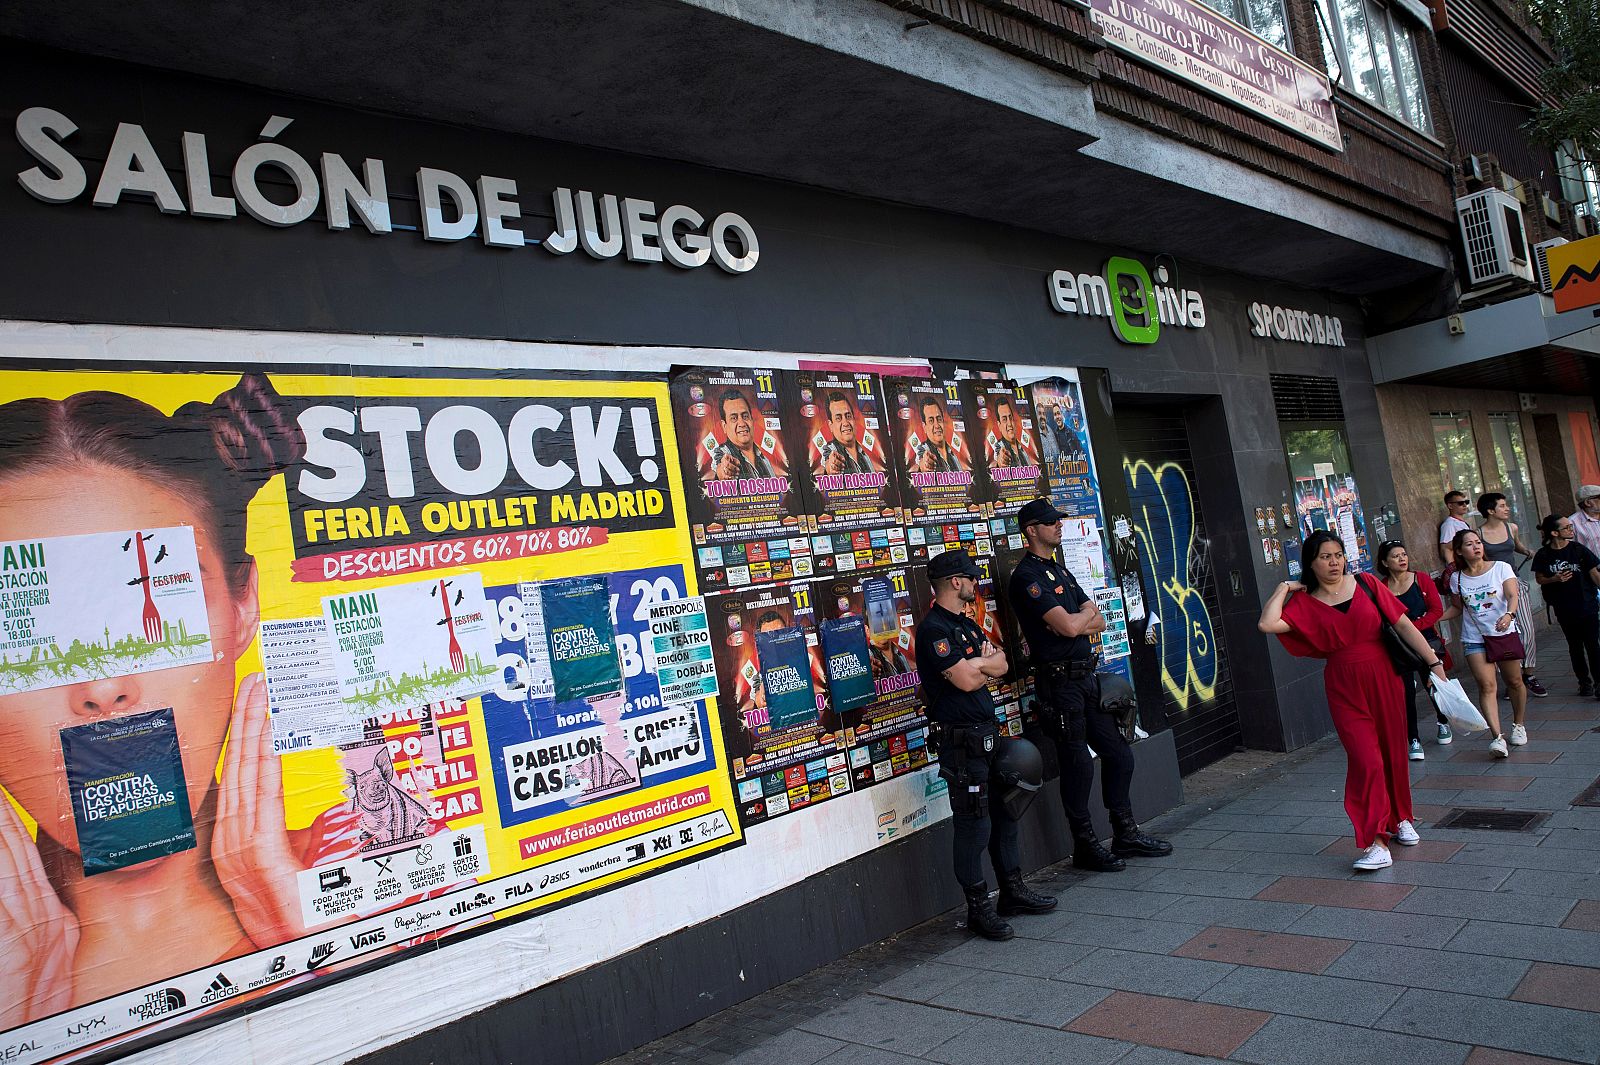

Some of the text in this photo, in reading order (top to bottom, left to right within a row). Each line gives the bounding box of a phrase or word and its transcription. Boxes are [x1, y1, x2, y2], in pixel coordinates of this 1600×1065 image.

[1136, 33, 1177, 67] Contable
[1185, 56, 1223, 89] Mercantil
[1231, 80, 1267, 110] Hipotecas
[15, 106, 760, 275] SALÓN DE JUEGO
[1247, 301, 1346, 348] SPORTS BAR
[757, 375, 773, 392] 11
[857, 380, 871, 394] 11
[757, 392, 777, 400] octubre
[946, 386, 958, 400] 11
[1015, 387, 1025, 399] 11
[297, 404, 659, 503] STOCK!
[815, 472, 886, 491] TONY ROSADO
[910, 470, 972, 488] TONY ROSADO
[991, 465, 1041, 482] TONY ROSADO
[704, 476, 789, 498] TONY ROSADO
[719, 494, 780, 505] CONCIERTO EXCLUSIVO
[303, 488, 665, 543] FERIA OUTLET MADRID
[3, 542, 46, 571] ANI
[323, 525, 593, 580] DESCUENTOS 60% 70% 80%
[789, 583, 810, 593] viernes
[892, 575, 906, 592] 11
[12, 596, 51, 609] VIVIENDA
[13, 588, 50, 601] DERECHO
[631, 574, 681, 622] 20
[793, 590, 810, 609] 11
[5, 607, 32, 619] DIGNA
[329, 592, 379, 621] MANI
[650, 601, 704, 618] METROPOLIS
[793, 607, 814, 616] octubre
[3, 617, 36, 632] 5/OCT
[1105, 610, 1123, 623] TEATRO
[262, 621, 304, 632] EXCURSIONES
[334, 614, 383, 637] FESTACIÓN
[652, 620, 679, 635] CINE
[8, 629, 33, 641] 18:00
[17, 635, 57, 649] BENAVENTE
[270, 638, 317, 648] BURGOS
[357, 637, 385, 649] VIVIENDA
[359, 631, 384, 642] DERECHO
[553, 627, 597, 644] CONTRA
[670, 631, 708, 647] TEATRO
[554, 636, 599, 652] LAS CASAS
[556, 651, 569, 661] DE
[568, 643, 610, 659] APUESTAS
[271, 649, 319, 659] VALLADOLID
[354, 648, 373, 658] DIGNA
[830, 654, 859, 668] CONTRA
[273, 660, 321, 670] SALAMANCA
[353, 655, 376, 668] 5/OCT
[832, 660, 861, 673] LAS CASAS
[273, 673, 309, 683] GUADALUPE
[364, 669, 391, 683] BENAVENTE
[676, 663, 714, 679] DOBLAJE
[767, 667, 799, 681] CONTRA
[834, 666, 868, 680] DE APUESTAS
[768, 674, 801, 686] LAS CASAS
[780, 680, 808, 692] APUESTAS
[879, 670, 922, 693] ROSADO
[634, 693, 660, 711] 10h
[512, 714, 688, 774] PABELLÓN CRISTA
[84, 770, 136, 788] MANIFESTACIÓN
[84, 773, 154, 801] CONTRA
[512, 763, 580, 802] CASA
[86, 784, 159, 812] LAS CASAS
[88, 790, 175, 822] DE APUESTAS
[523, 790, 707, 856] www.feriaoutletmadrid.com
[130, 837, 171, 853] Cuatro Caminos
[452, 854, 478, 867] SORTEO
[453, 861, 480, 874] 1000€
[578, 854, 622, 875] wonderbra
[407, 866, 437, 879] SERVICIO
[373, 882, 402, 896] GASTRO
[376, 877, 397, 888] ZONA
[412, 876, 446, 891] GRATUITO
[313, 886, 364, 909] FOOD TRUCKS
[375, 888, 402, 902] NOMICA
[504, 881, 534, 901] FILA
[322, 895, 353, 910] MUSICA
[325, 902, 356, 917] DIRECTO
[449, 894, 496, 918] ellesse
[395, 915, 417, 932] Pepe
[350, 927, 387, 951] VANS
[311, 941, 336, 959] NIKE
[248, 967, 297, 989] new balance
[144, 988, 167, 1002] THE
[200, 984, 239, 1005] adidas
[129, 996, 168, 1017] NORTH
[140, 1006, 169, 1022] FACE
[67, 1015, 107, 1037] NYX
